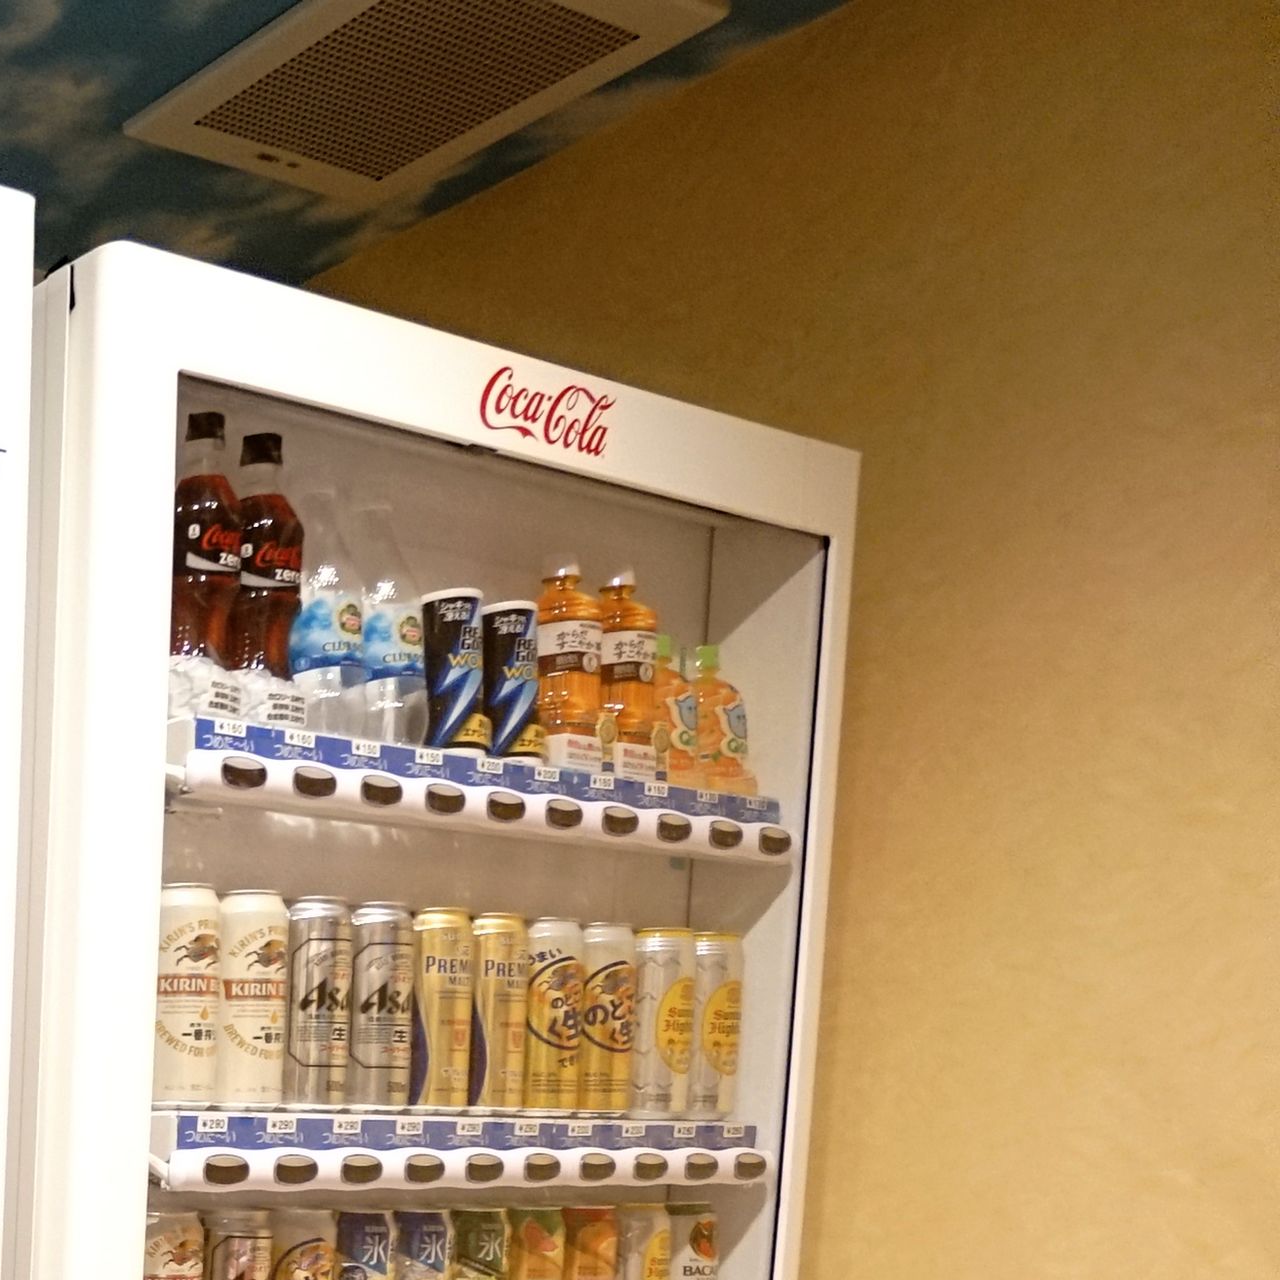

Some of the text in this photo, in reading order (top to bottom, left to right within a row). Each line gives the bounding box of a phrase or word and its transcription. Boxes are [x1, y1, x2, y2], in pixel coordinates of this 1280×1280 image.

[480, 366, 617, 457] Coca-Cola
[219, 552, 240, 568] zer
[160, 977, 208, 992] KIRIN
[231, 982, 278, 997] KIRIN
[331, 1028, 347, 1042] 生
[392, 1029, 408, 1044] 生
[361, 1234, 389, 1266] 氷
[420, 1234, 445, 1265] 氷
[478, 1232, 502, 1262] 氷
